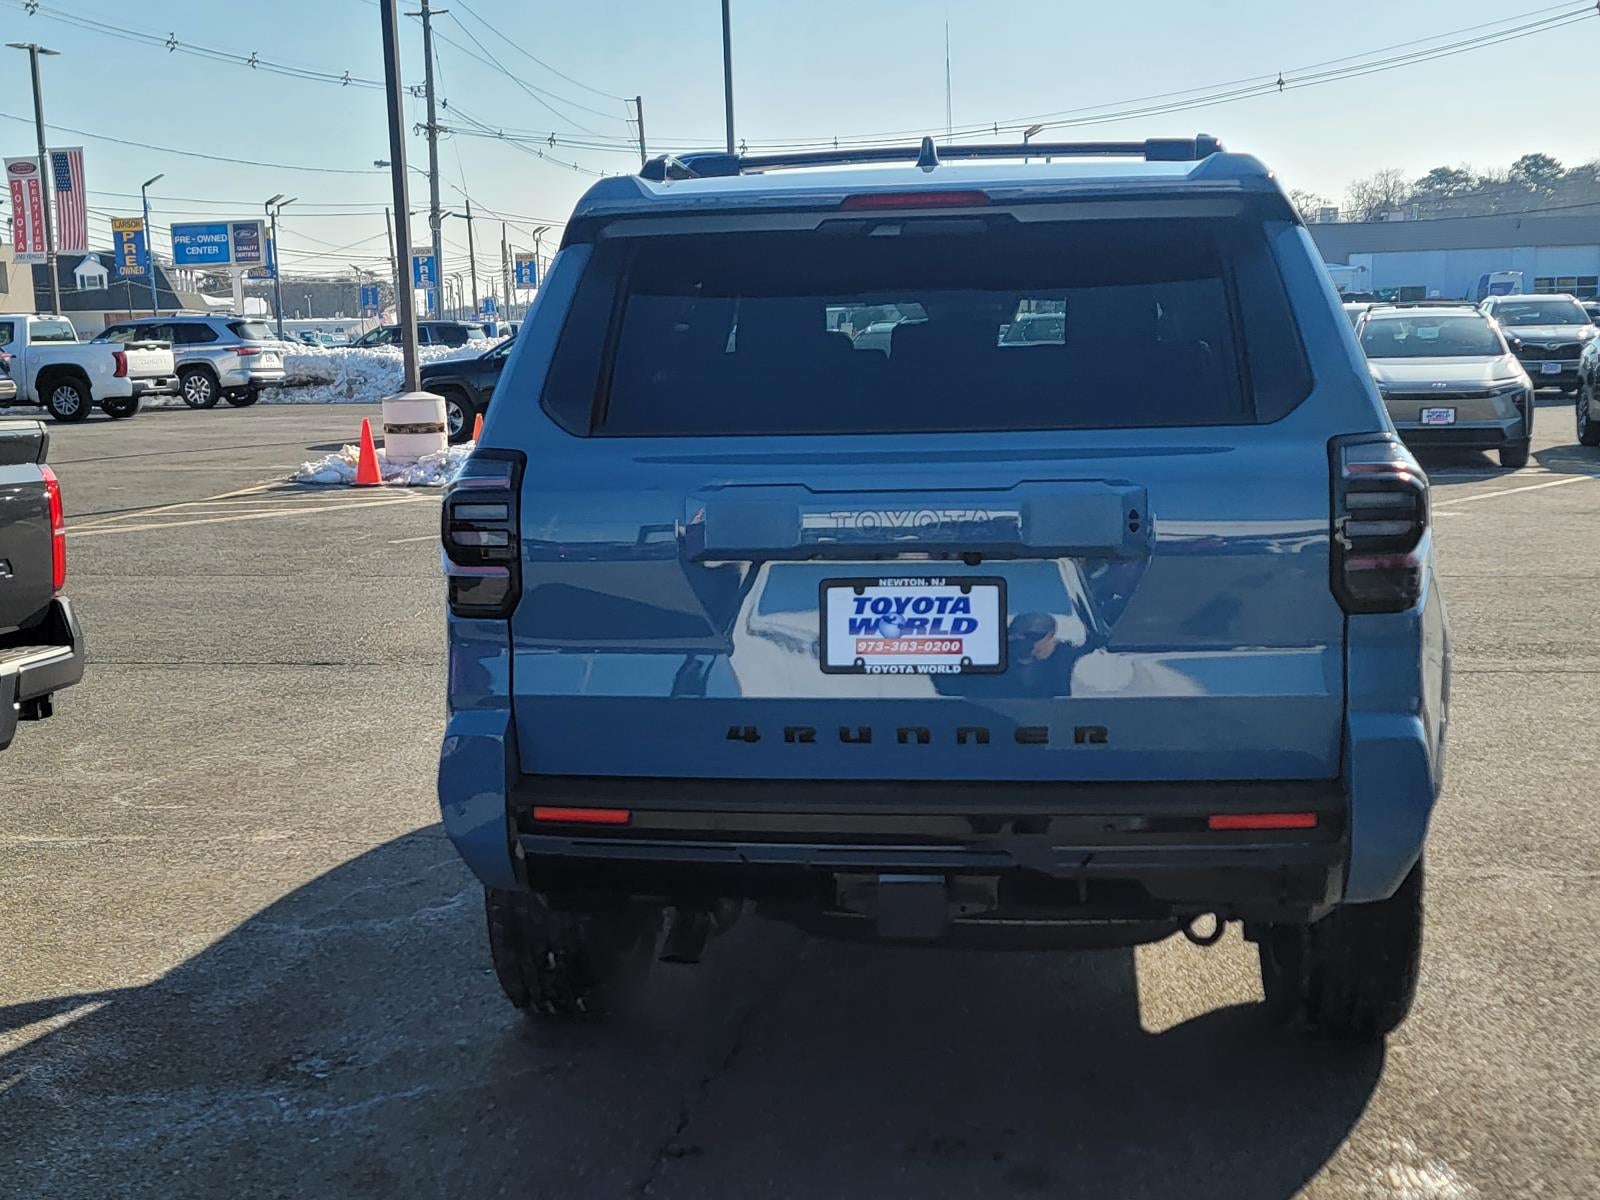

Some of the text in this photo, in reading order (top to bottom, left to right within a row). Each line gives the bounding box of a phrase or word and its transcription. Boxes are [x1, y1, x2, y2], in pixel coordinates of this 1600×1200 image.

[13, 181, 25, 250] TOYOTA
[30, 180, 42, 251] CERTIFIED
[122, 231, 137, 266] PRE
[185, 245, 220, 255] CENTER
[119, 265, 145, 275] OWNED
[418, 256, 429, 281] PRE
[829, 509, 997, 537] TOYOTA
[931, 578, 946, 586] NJ
[852, 596, 971, 615] TOYOTA
[857, 641, 961, 652] 973-383-0200
[864, 664, 962, 674] TOYOTA WORLD
